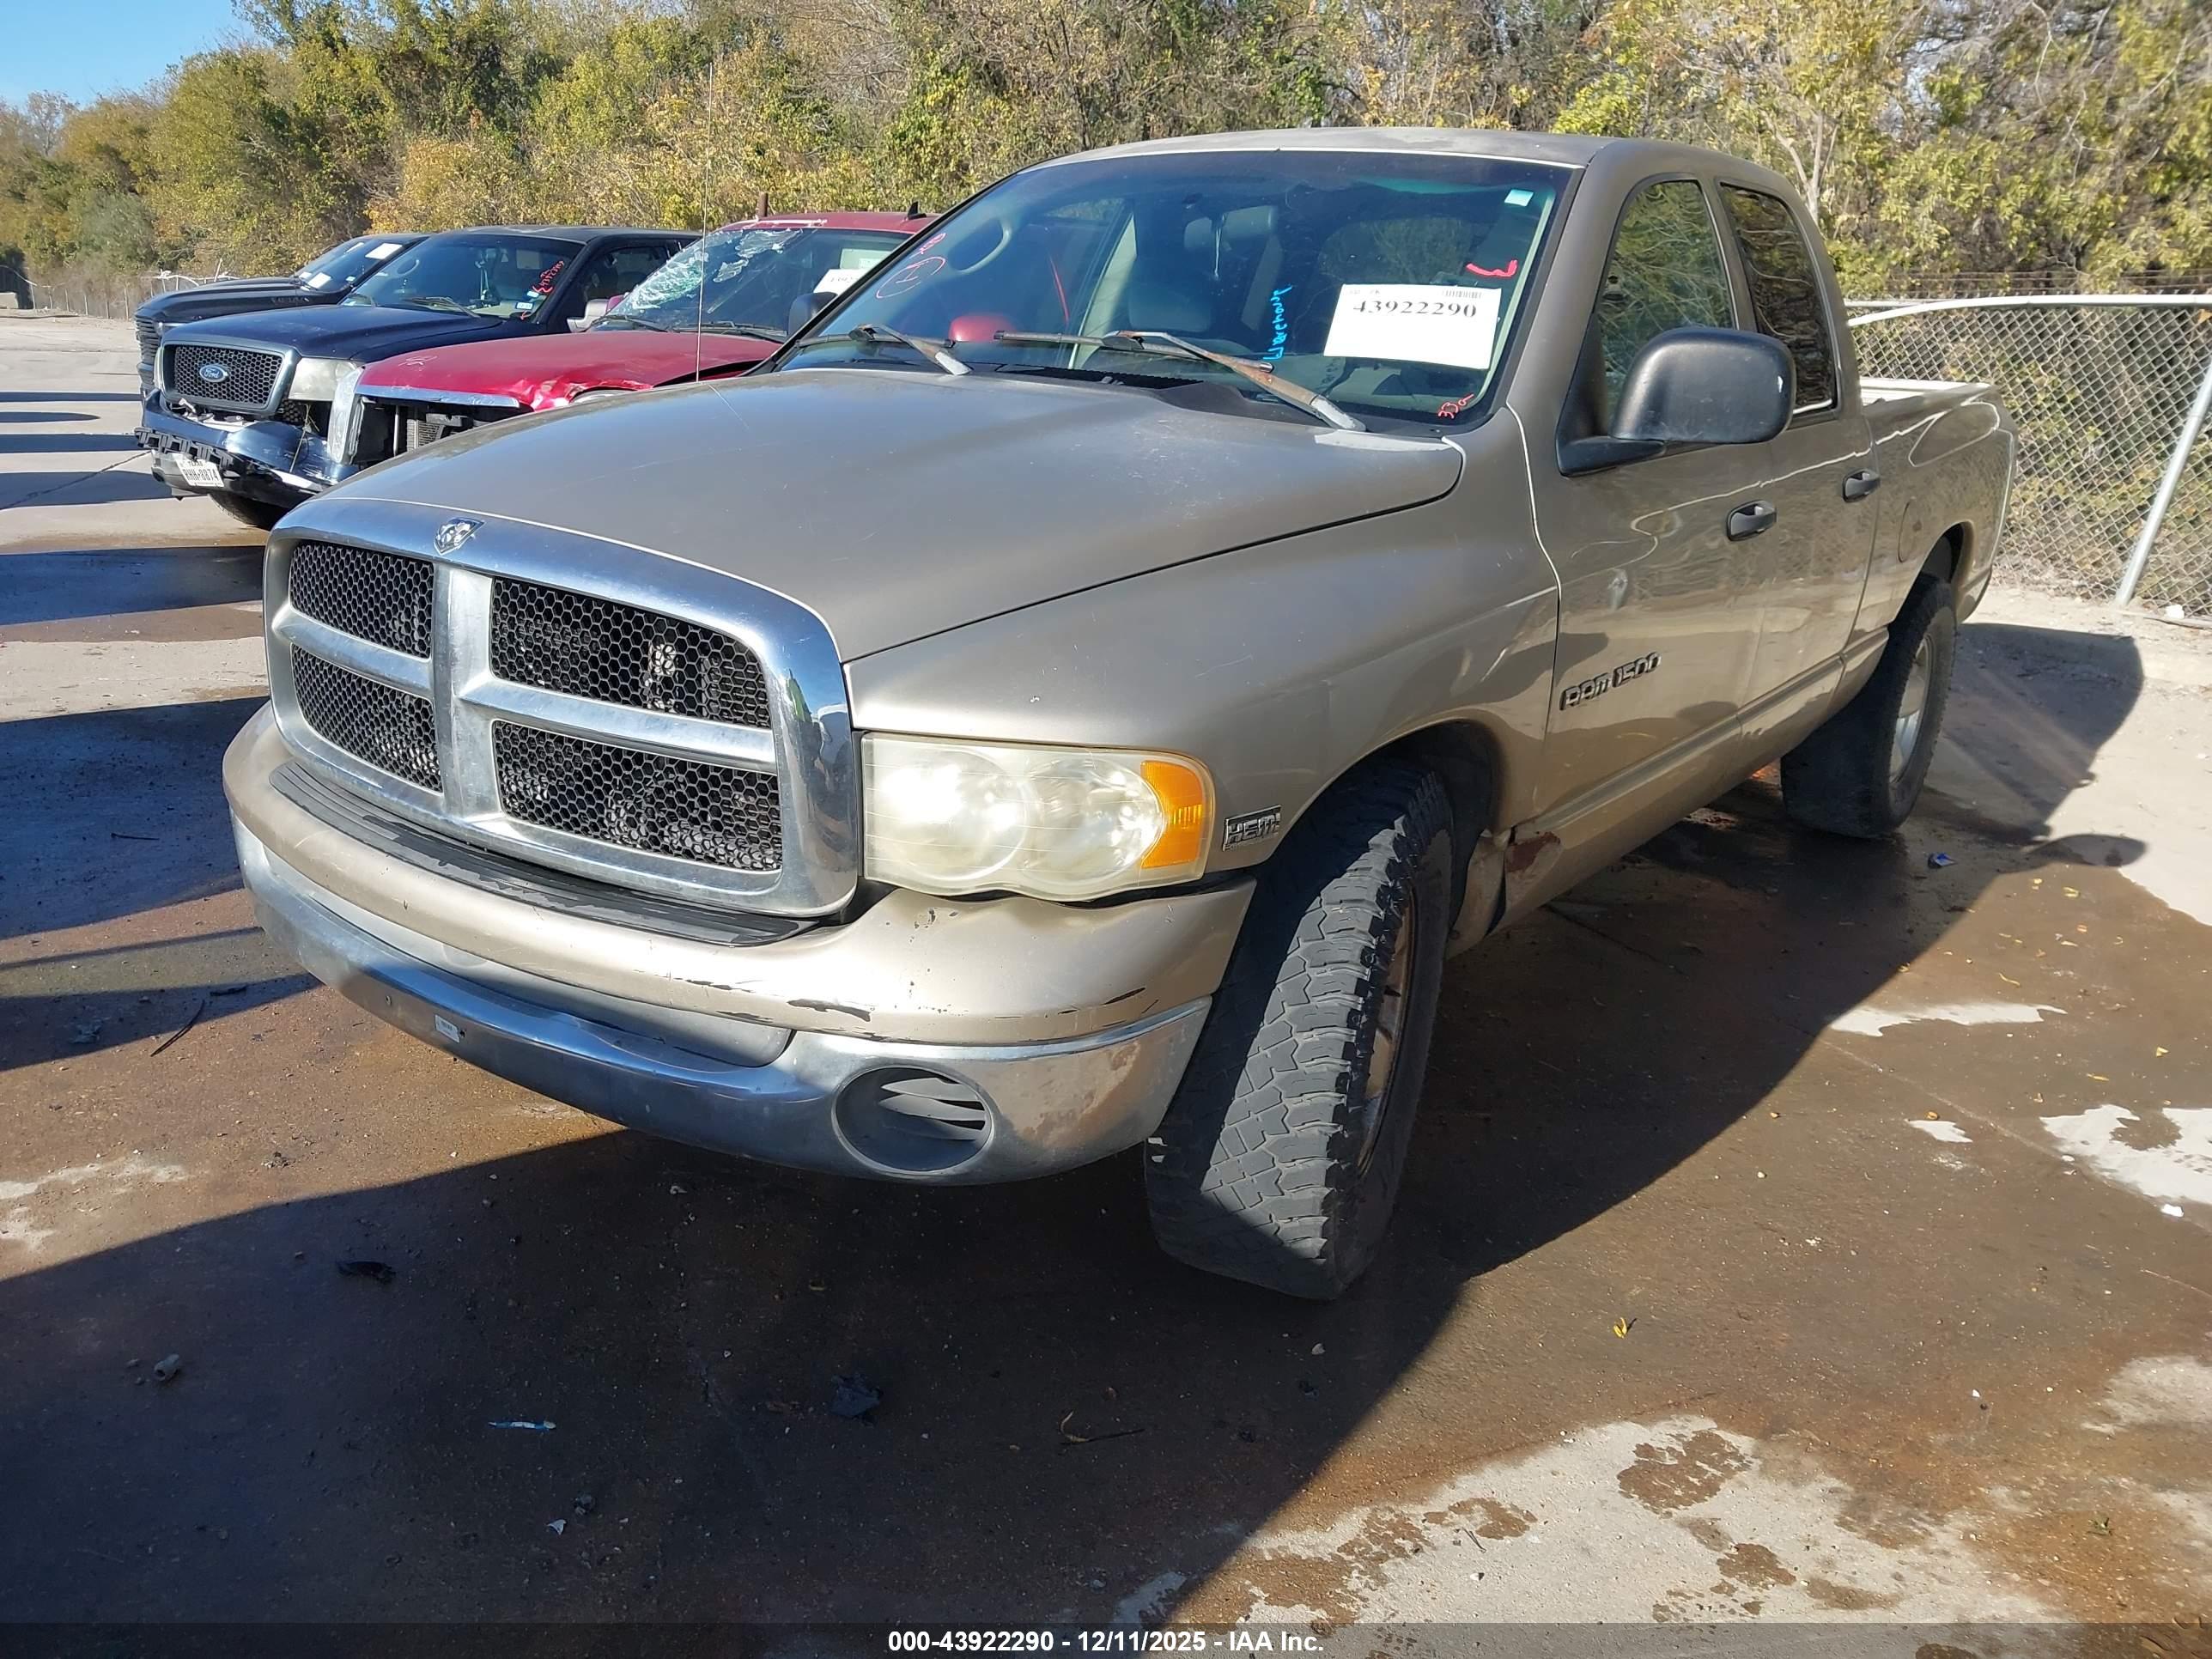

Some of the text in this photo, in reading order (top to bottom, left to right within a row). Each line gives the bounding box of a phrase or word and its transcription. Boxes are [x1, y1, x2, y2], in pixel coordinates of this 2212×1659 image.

[1352, 301, 1477, 318] 43922290
[1559, 651, 1662, 711] RAM 1500
[1227, 812, 1281, 843] HEMI
